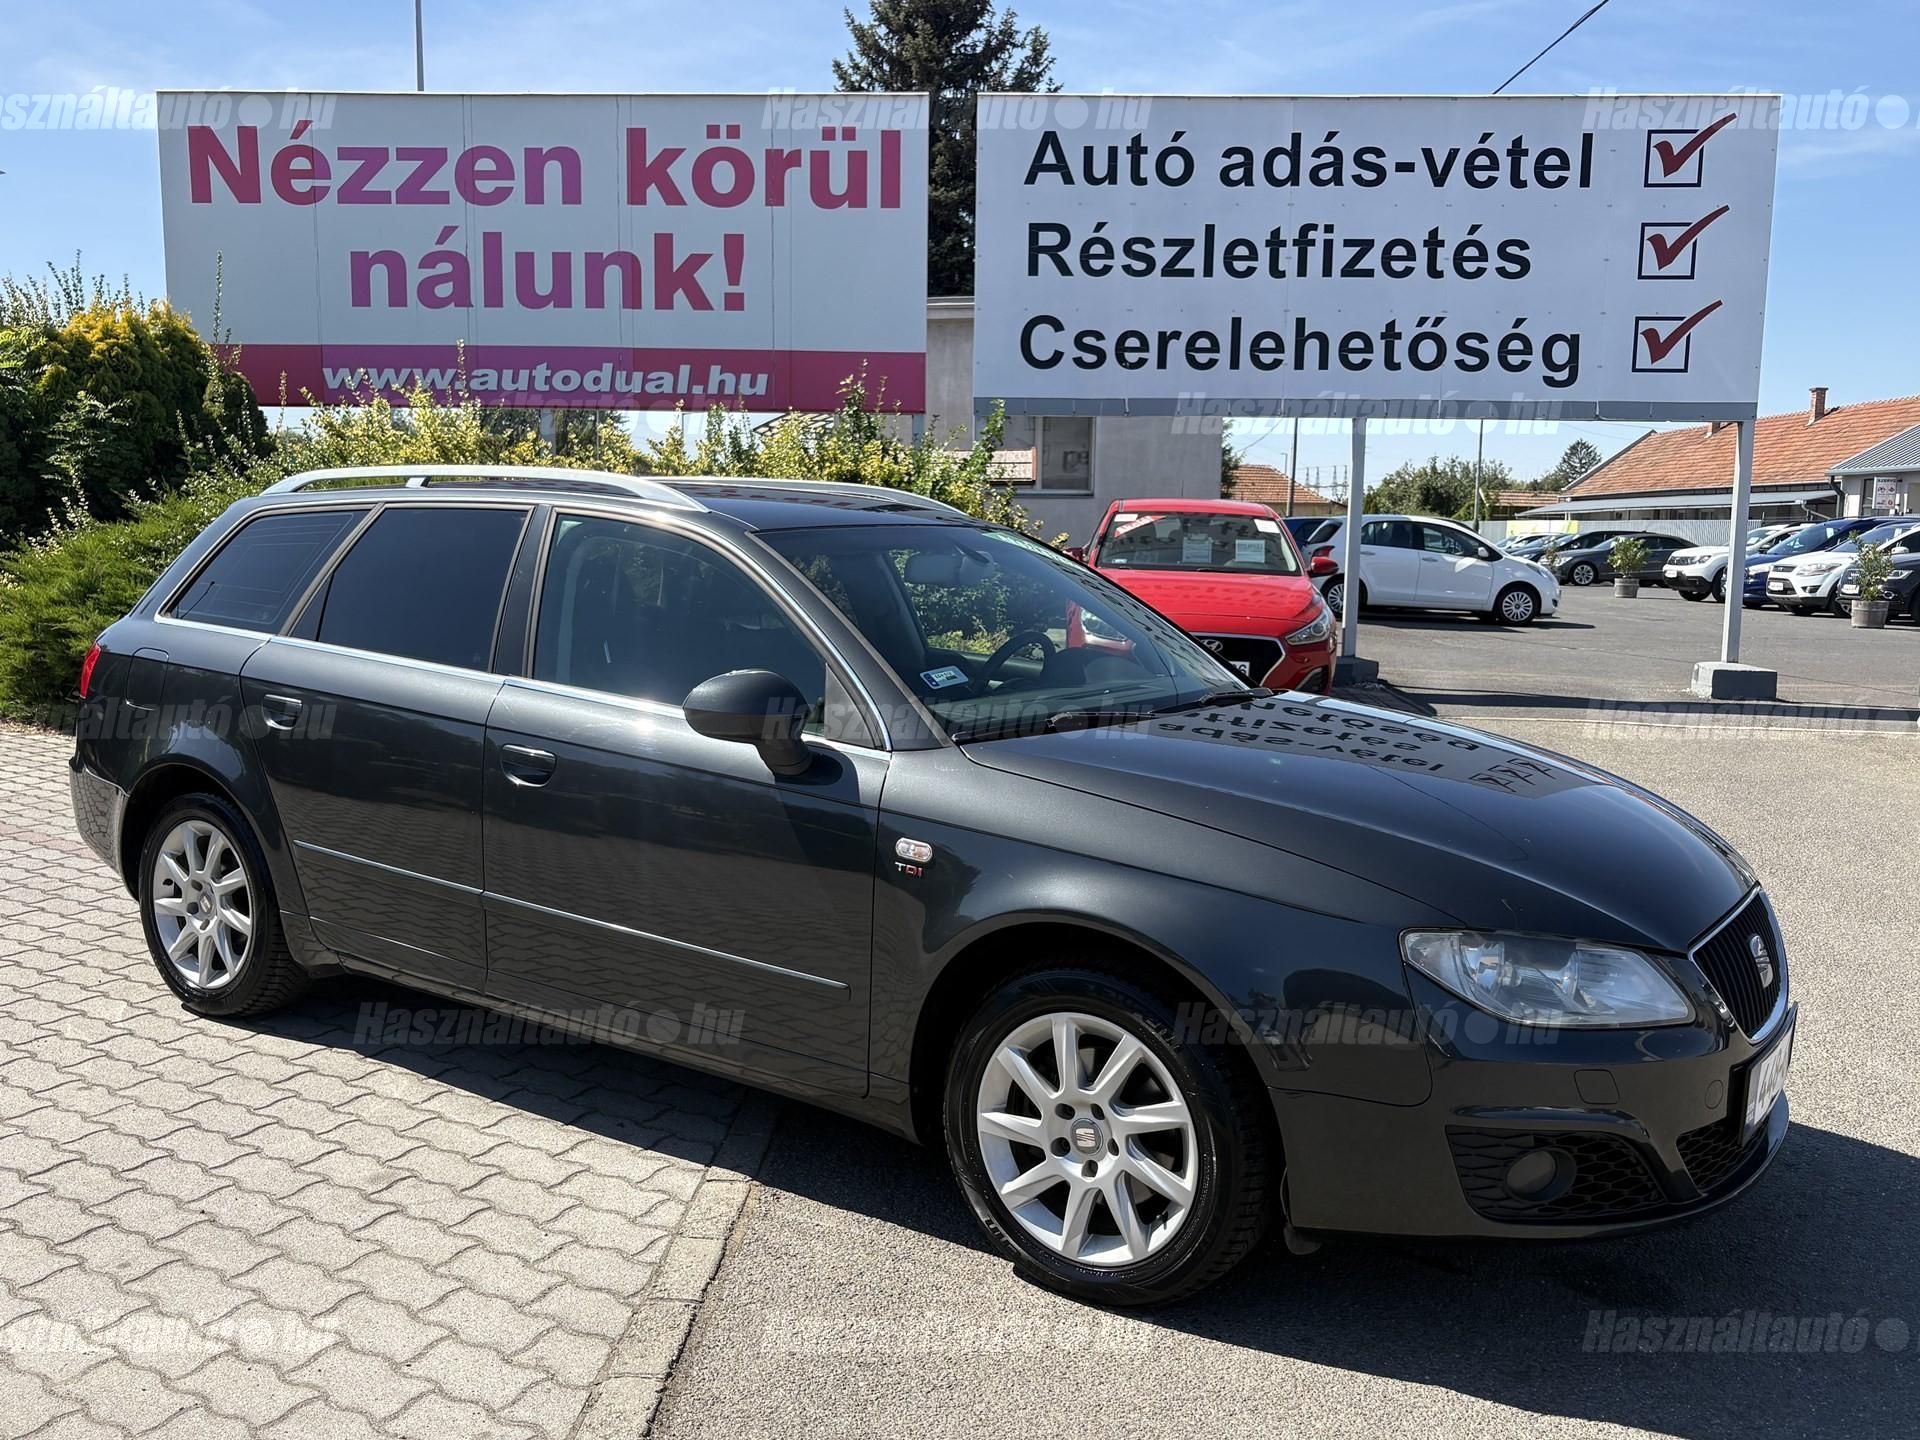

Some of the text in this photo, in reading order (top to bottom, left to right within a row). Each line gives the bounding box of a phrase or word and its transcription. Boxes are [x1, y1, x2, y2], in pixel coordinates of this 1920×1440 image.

[189, 120, 901, 209] Nézzen körül
[1023, 130, 1594, 189] Autó adás-vétel
[350, 227, 745, 312] nálunk!
[1027, 221, 1531, 280] Részletfizetés
[322, 362, 769, 397] www.autodual.hu
[1020, 314, 1580, 389] Cserelehetőség
[895, 861, 923, 877] TDI
